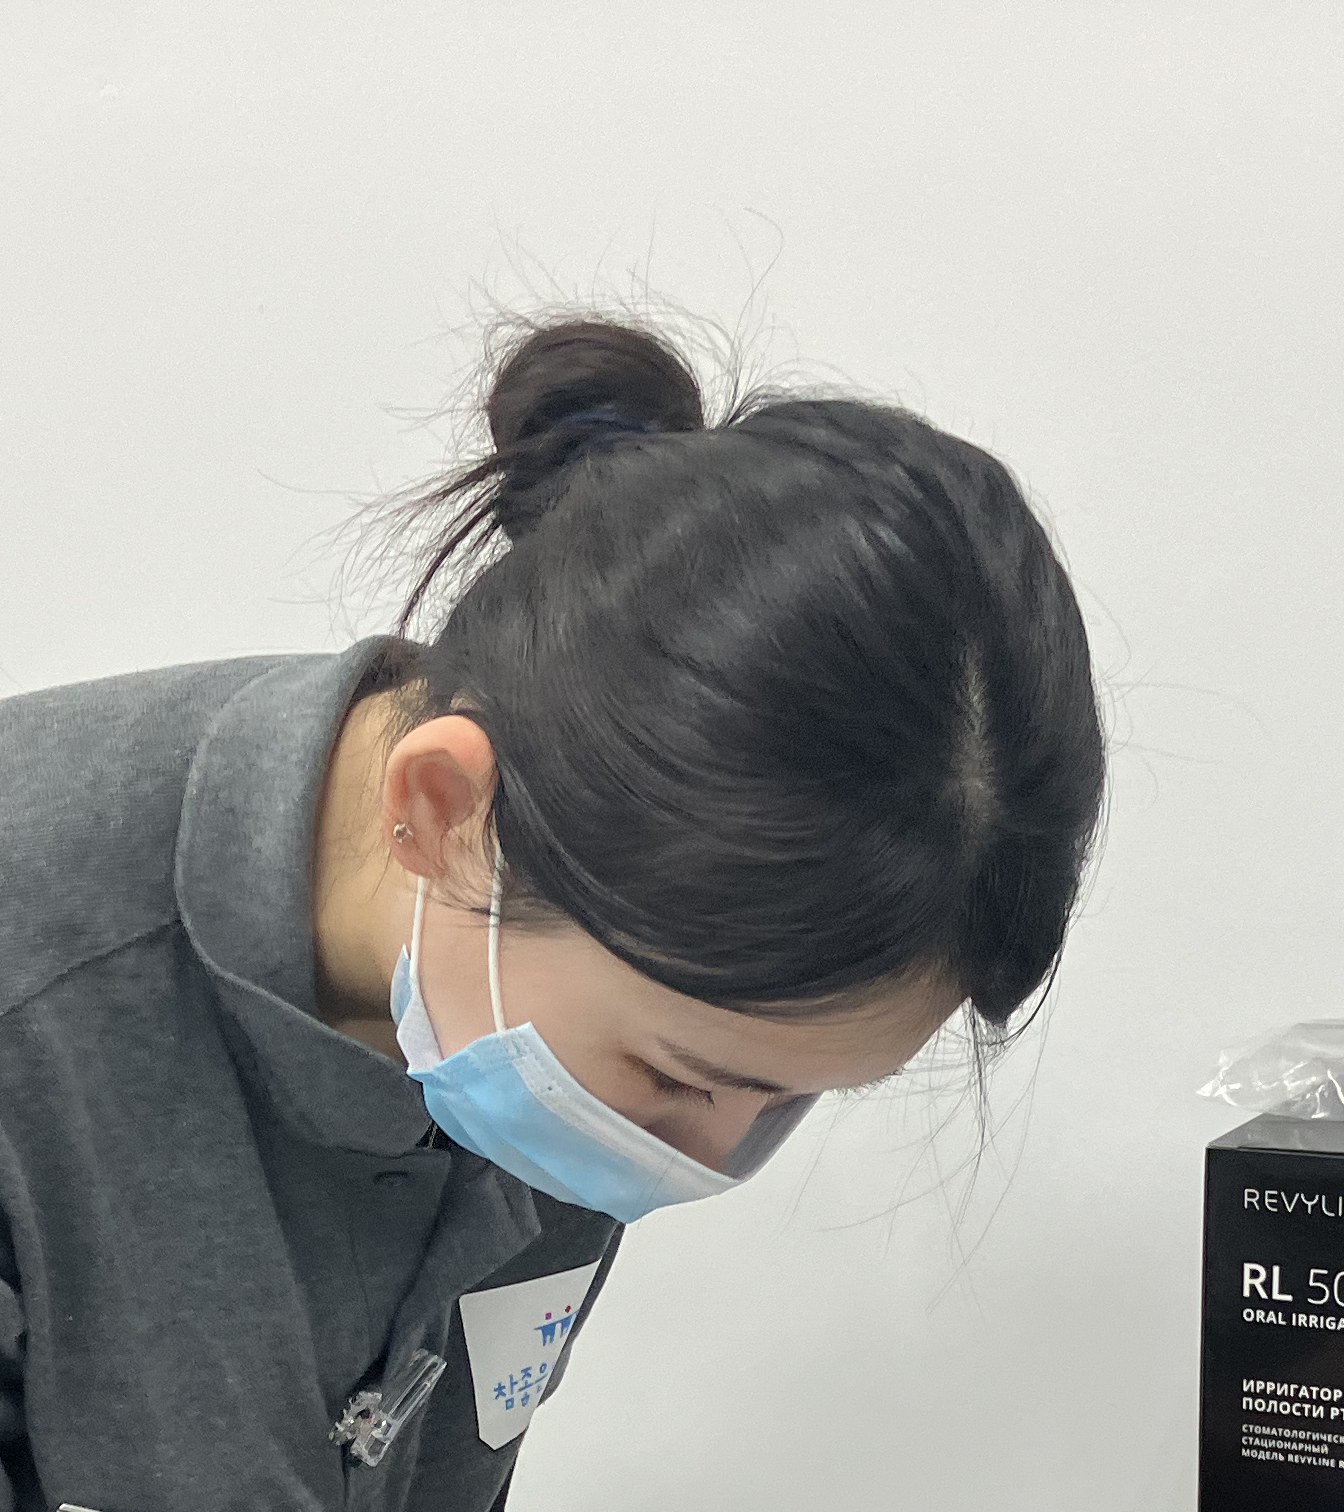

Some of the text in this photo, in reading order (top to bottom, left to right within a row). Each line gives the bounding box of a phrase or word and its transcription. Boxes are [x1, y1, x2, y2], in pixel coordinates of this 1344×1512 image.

[1242, 1262, 1293, 1302] RL
[1242, 1308, 1287, 1326] ORAL
[1242, 1378, 1343, 1402] ИРРИГАТОР
[1242, 1397, 1324, 1418] ПОЛОСТИ
[1241, 1436, 1329, 1455] СТАЦИОНАРНЫЙ
[1241, 1448, 1285, 1462] МОДЕЛЬ
[1288, 1453, 1336, 1468] REVYLINE
